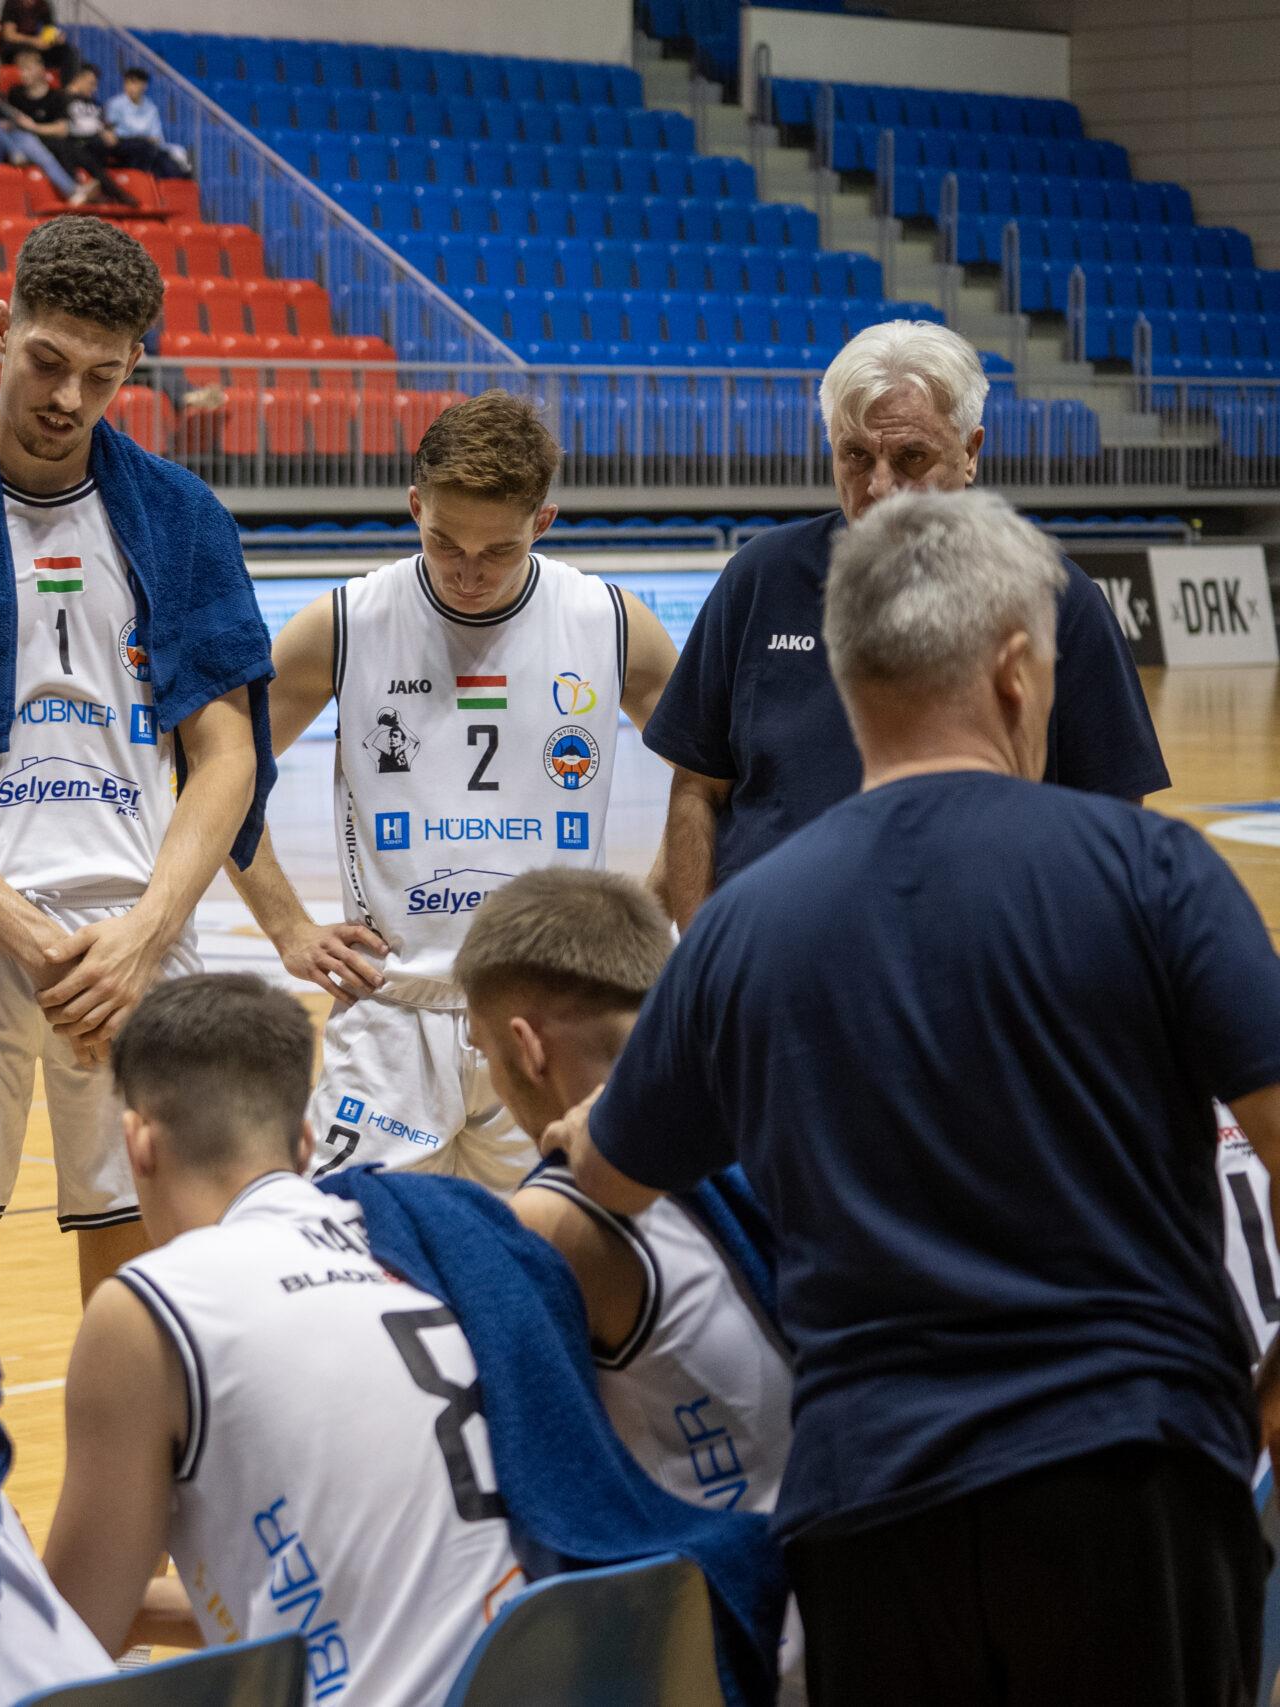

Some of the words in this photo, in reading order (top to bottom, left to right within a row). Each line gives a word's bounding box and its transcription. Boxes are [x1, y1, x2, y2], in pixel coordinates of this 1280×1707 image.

[55, 608, 74, 676] 1
[768, 634, 816, 651] JAKO
[387, 679, 432, 695] JAKO
[467, 724, 500, 791] 2
[424, 818, 543, 841] HÜBNER
[408, 888, 488, 915] Selye
[367, 1111, 440, 1149] HÜBNER
